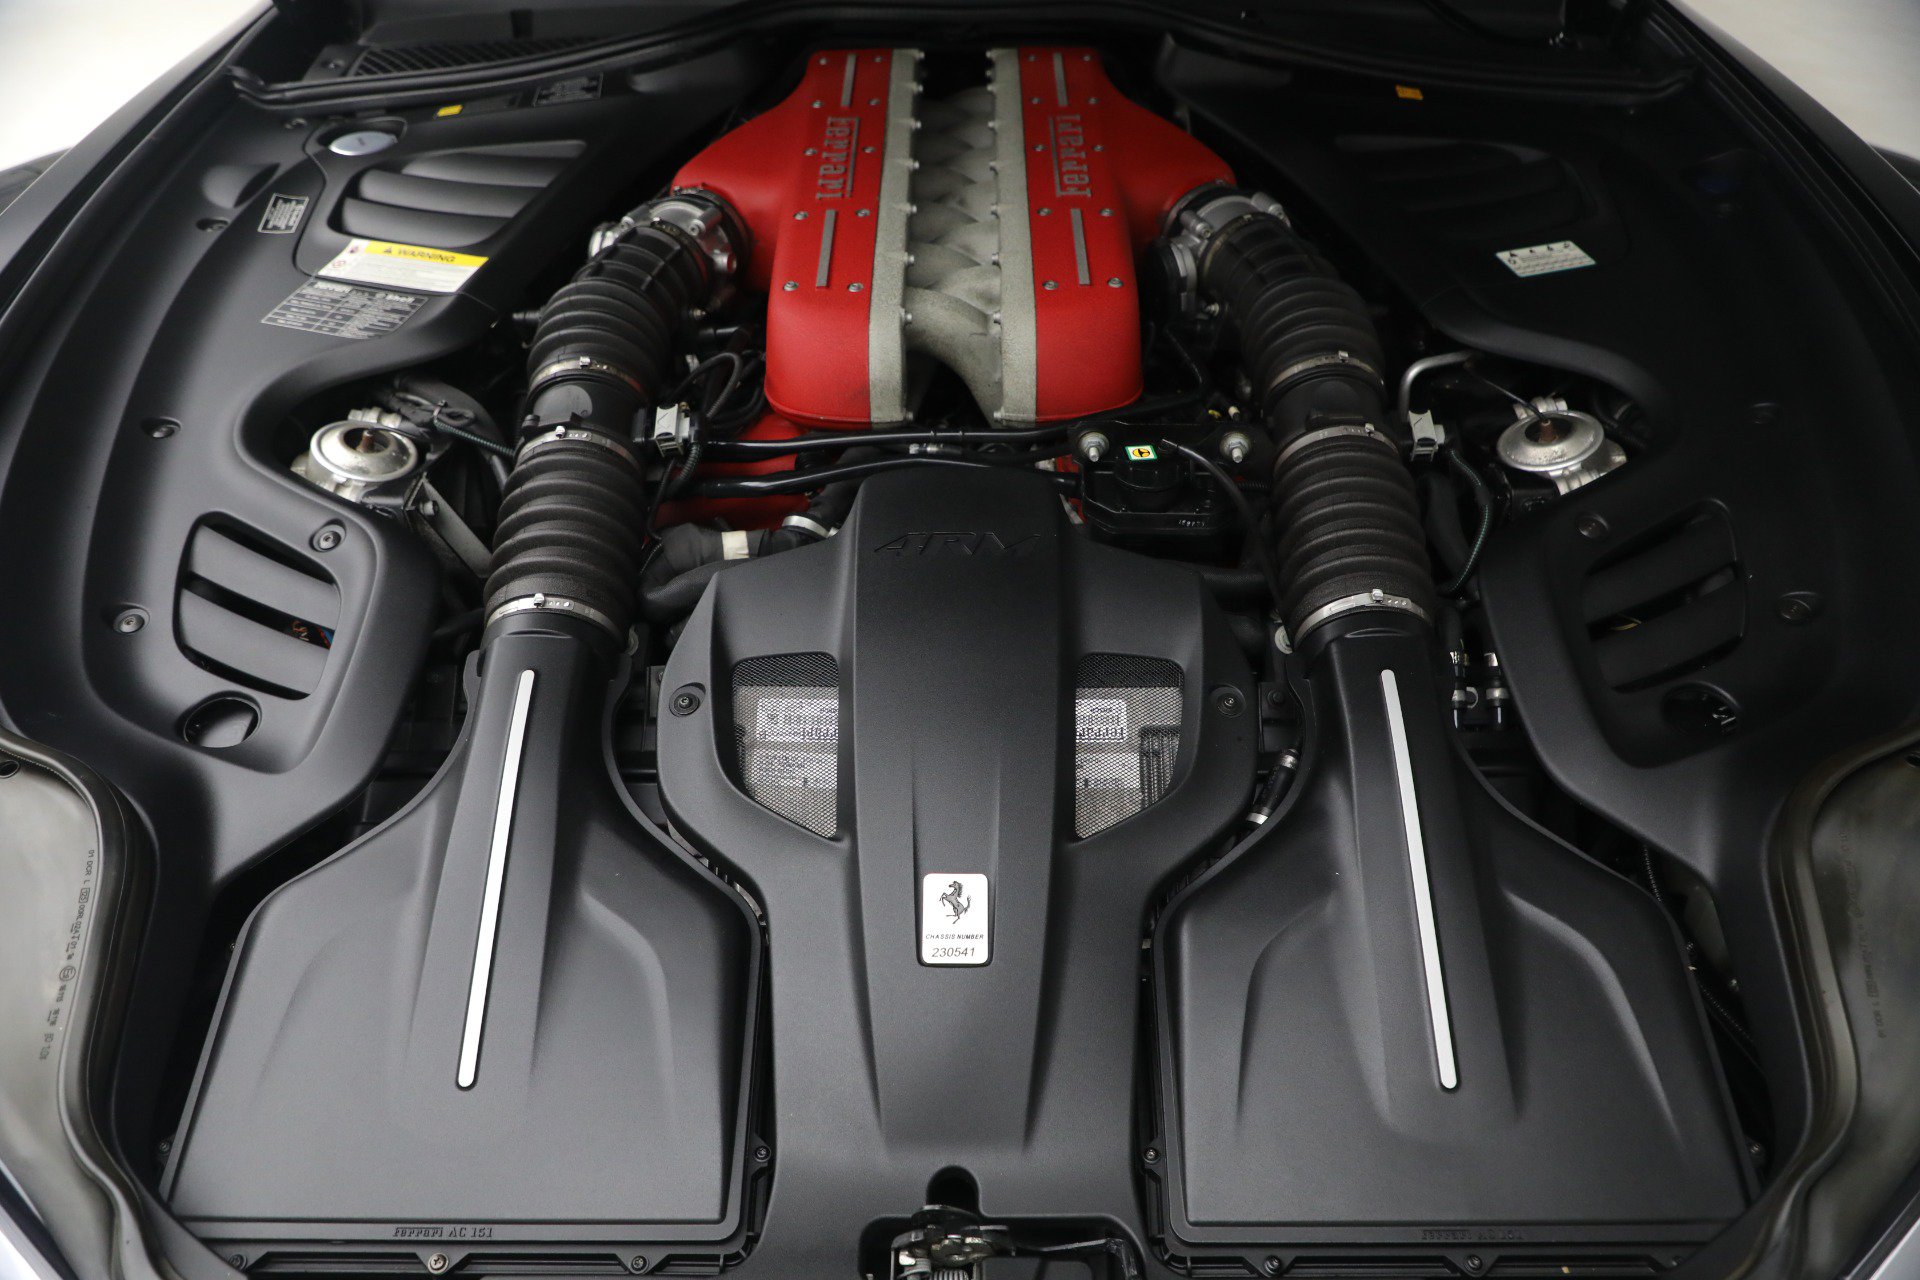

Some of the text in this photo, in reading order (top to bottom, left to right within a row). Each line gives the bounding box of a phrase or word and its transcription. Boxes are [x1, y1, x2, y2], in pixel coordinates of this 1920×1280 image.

[816, 117, 861, 200] Ferrari
[1049, 114, 1092, 197] Ferrari
[397, 249, 456, 263] WARNING
[874, 531, 1042, 557] 4RM
[85, 860, 94, 876] DCR
[931, 946, 975, 958] 230541
[393, 1226, 493, 1238] Ferrari AC 151
